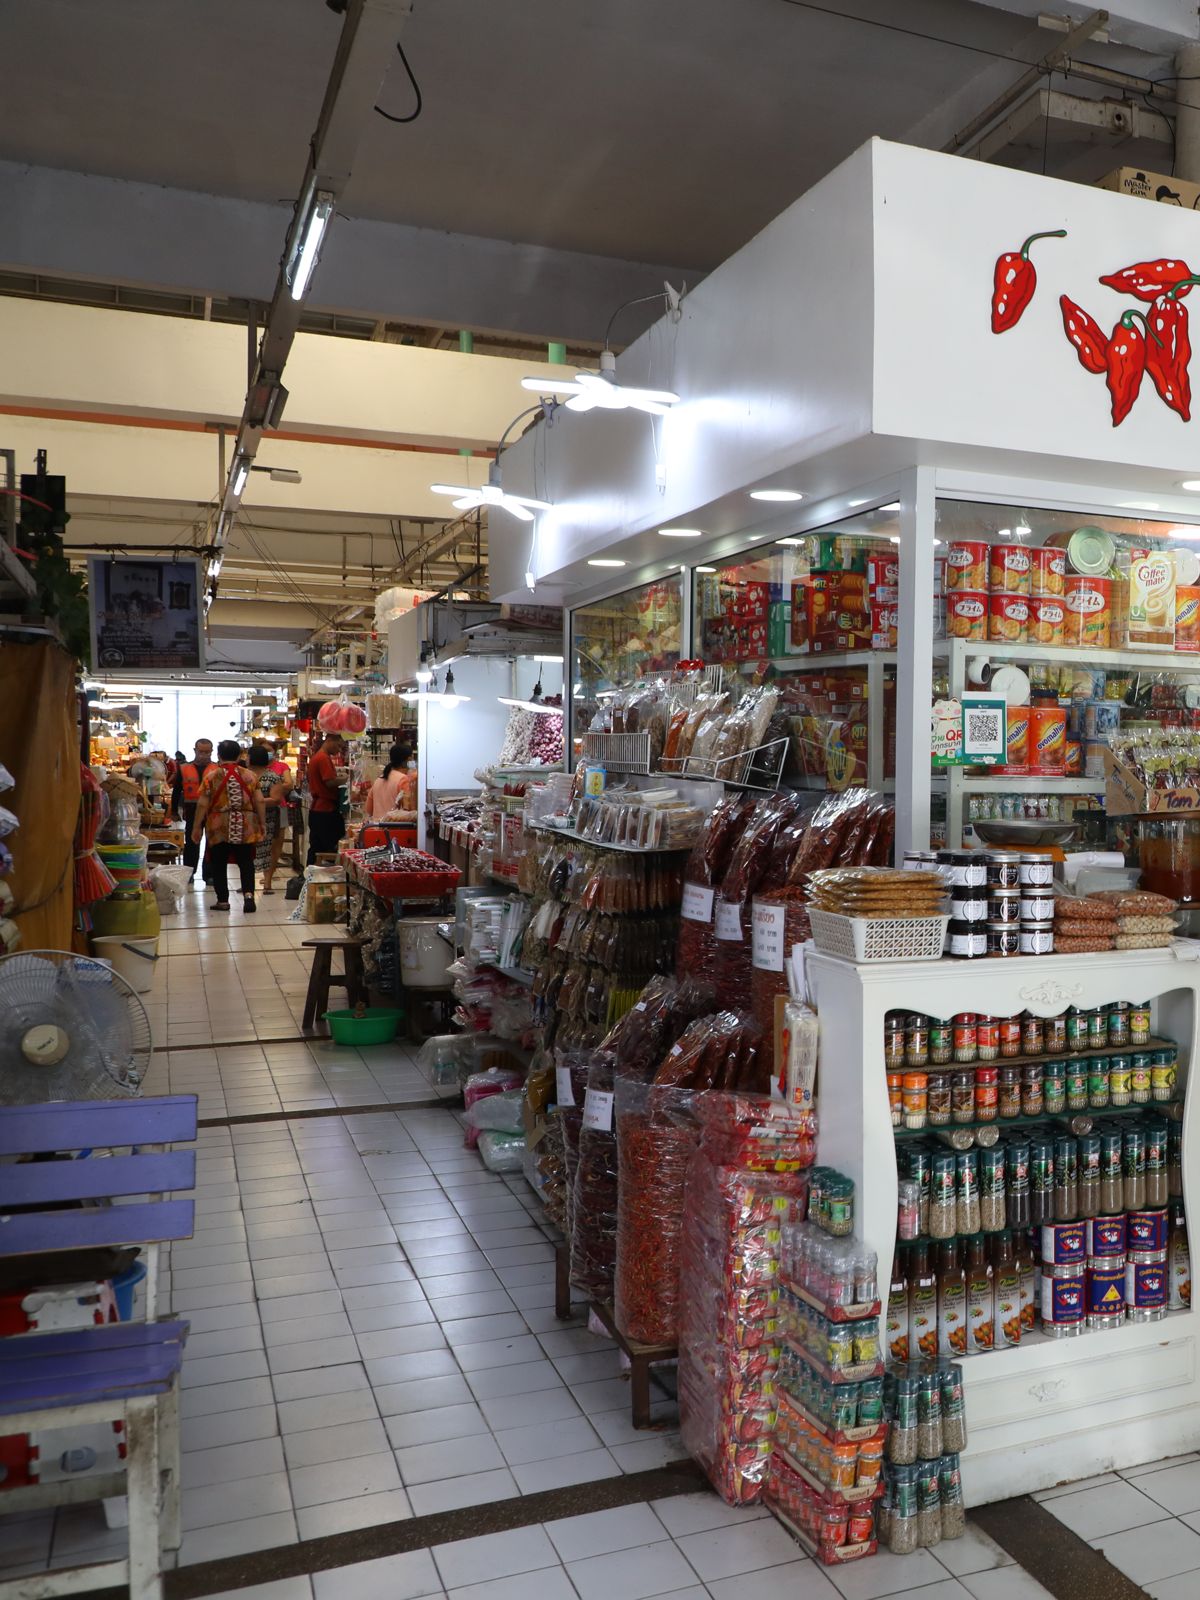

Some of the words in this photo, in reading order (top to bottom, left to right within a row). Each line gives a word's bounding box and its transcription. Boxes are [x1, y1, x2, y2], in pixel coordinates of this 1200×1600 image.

[1054, 562, 1065, 570] プラ
[1138, 564, 1167, 581] Coffee
[1145, 576, 1166, 587] mate
[1175, 599, 1200, 625] vomaltine
[1164, 790, 1193, 809] Tom
